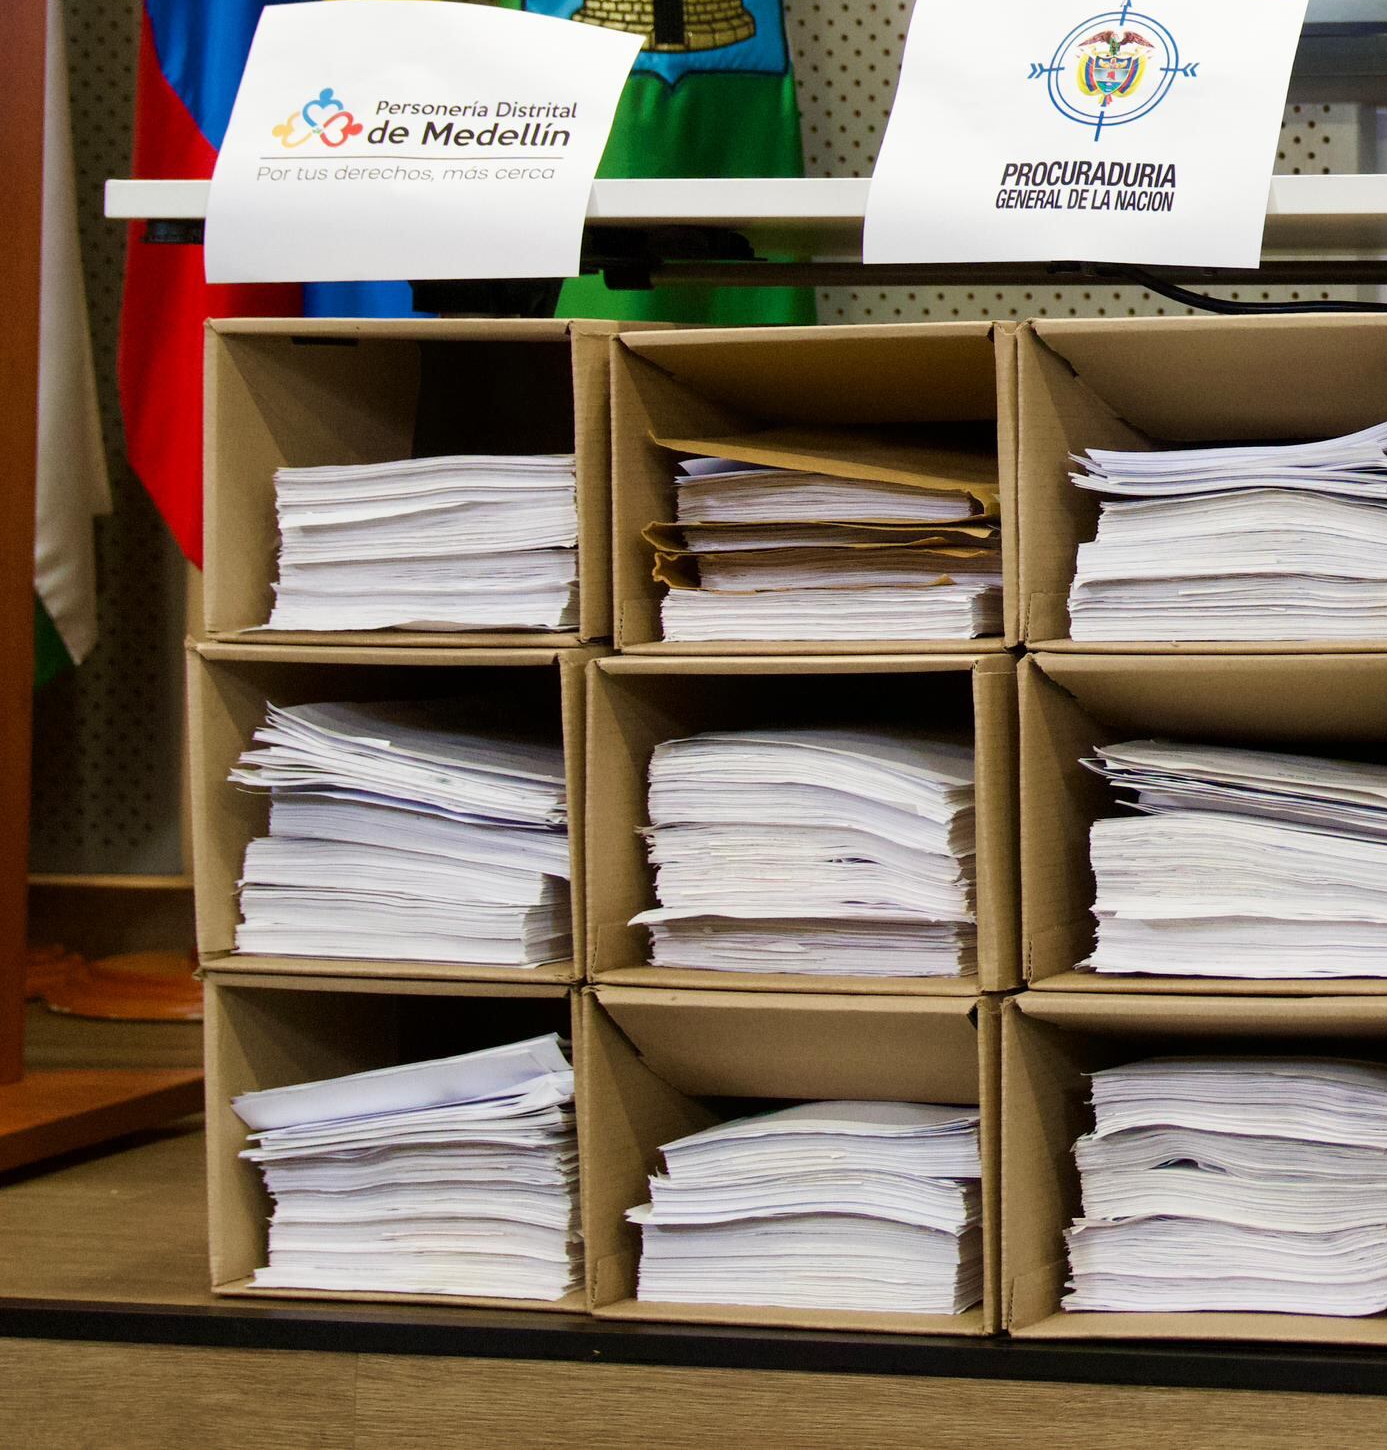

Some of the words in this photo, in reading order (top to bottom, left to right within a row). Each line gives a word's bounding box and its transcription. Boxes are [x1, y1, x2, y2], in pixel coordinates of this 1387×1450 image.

[375, 100, 489, 118] Personería
[495, 101, 577, 119] Distrital
[367, 120, 410, 145] de
[421, 121, 570, 147] Medellín
[257, 165, 291, 182] Por
[296, 166, 328, 181] tus
[334, 164, 434, 182] derechos,
[442, 165, 489, 181] más
[494, 167, 556, 181] cerca
[1001, 161, 1176, 188] PROCURADURIA
[996, 189, 1063, 210] GENERAL
[1067, 189, 1088, 210] DE
[1090, 190, 1111, 210] LA
[1114, 190, 1175, 212] NACION
